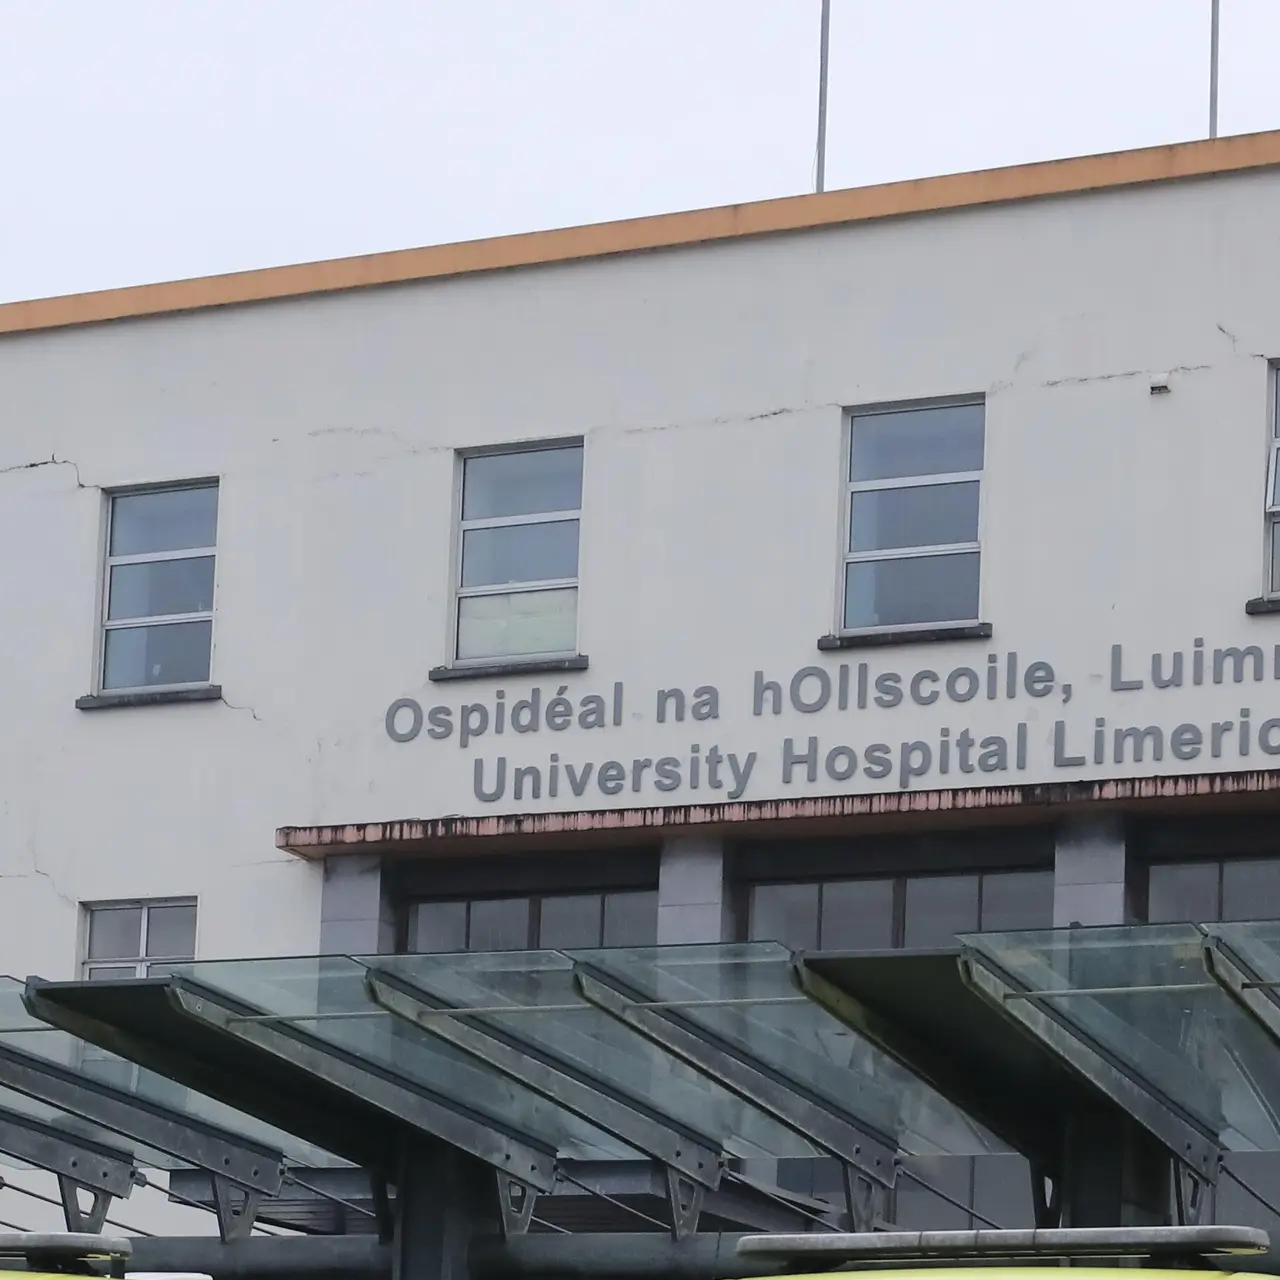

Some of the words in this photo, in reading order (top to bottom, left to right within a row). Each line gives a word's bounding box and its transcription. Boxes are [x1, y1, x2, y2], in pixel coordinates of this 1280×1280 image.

[385, 680, 623, 748] Ospidéal
[656, 683, 720, 724] na
[752, 651, 1073, 716] hOllscoile,
[473, 743, 757, 802] University
[782, 722, 1027, 788] Hospital
